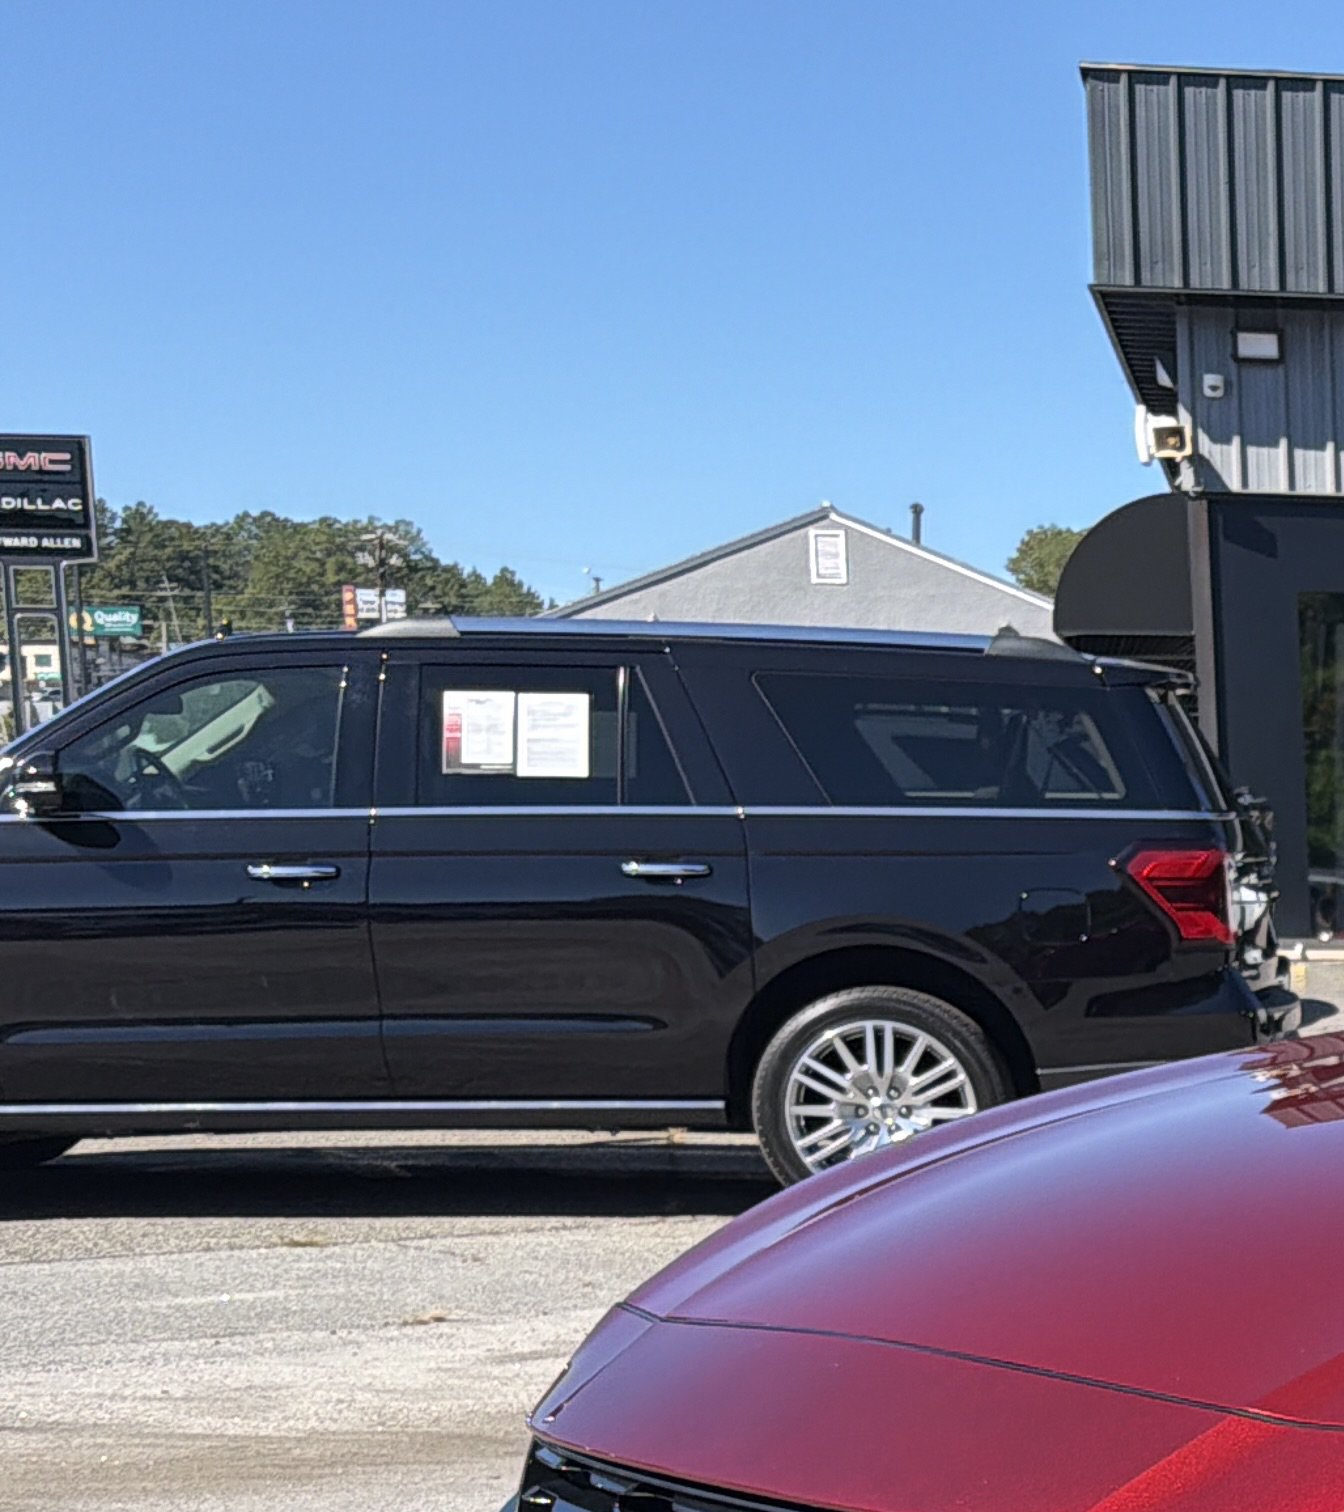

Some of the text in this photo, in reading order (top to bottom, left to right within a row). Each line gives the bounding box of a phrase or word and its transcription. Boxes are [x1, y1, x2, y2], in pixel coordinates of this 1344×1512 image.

[0, 451, 71, 471] MC
[41, 537, 81, 548] ALLEN
[94, 611, 139, 627] Quality
